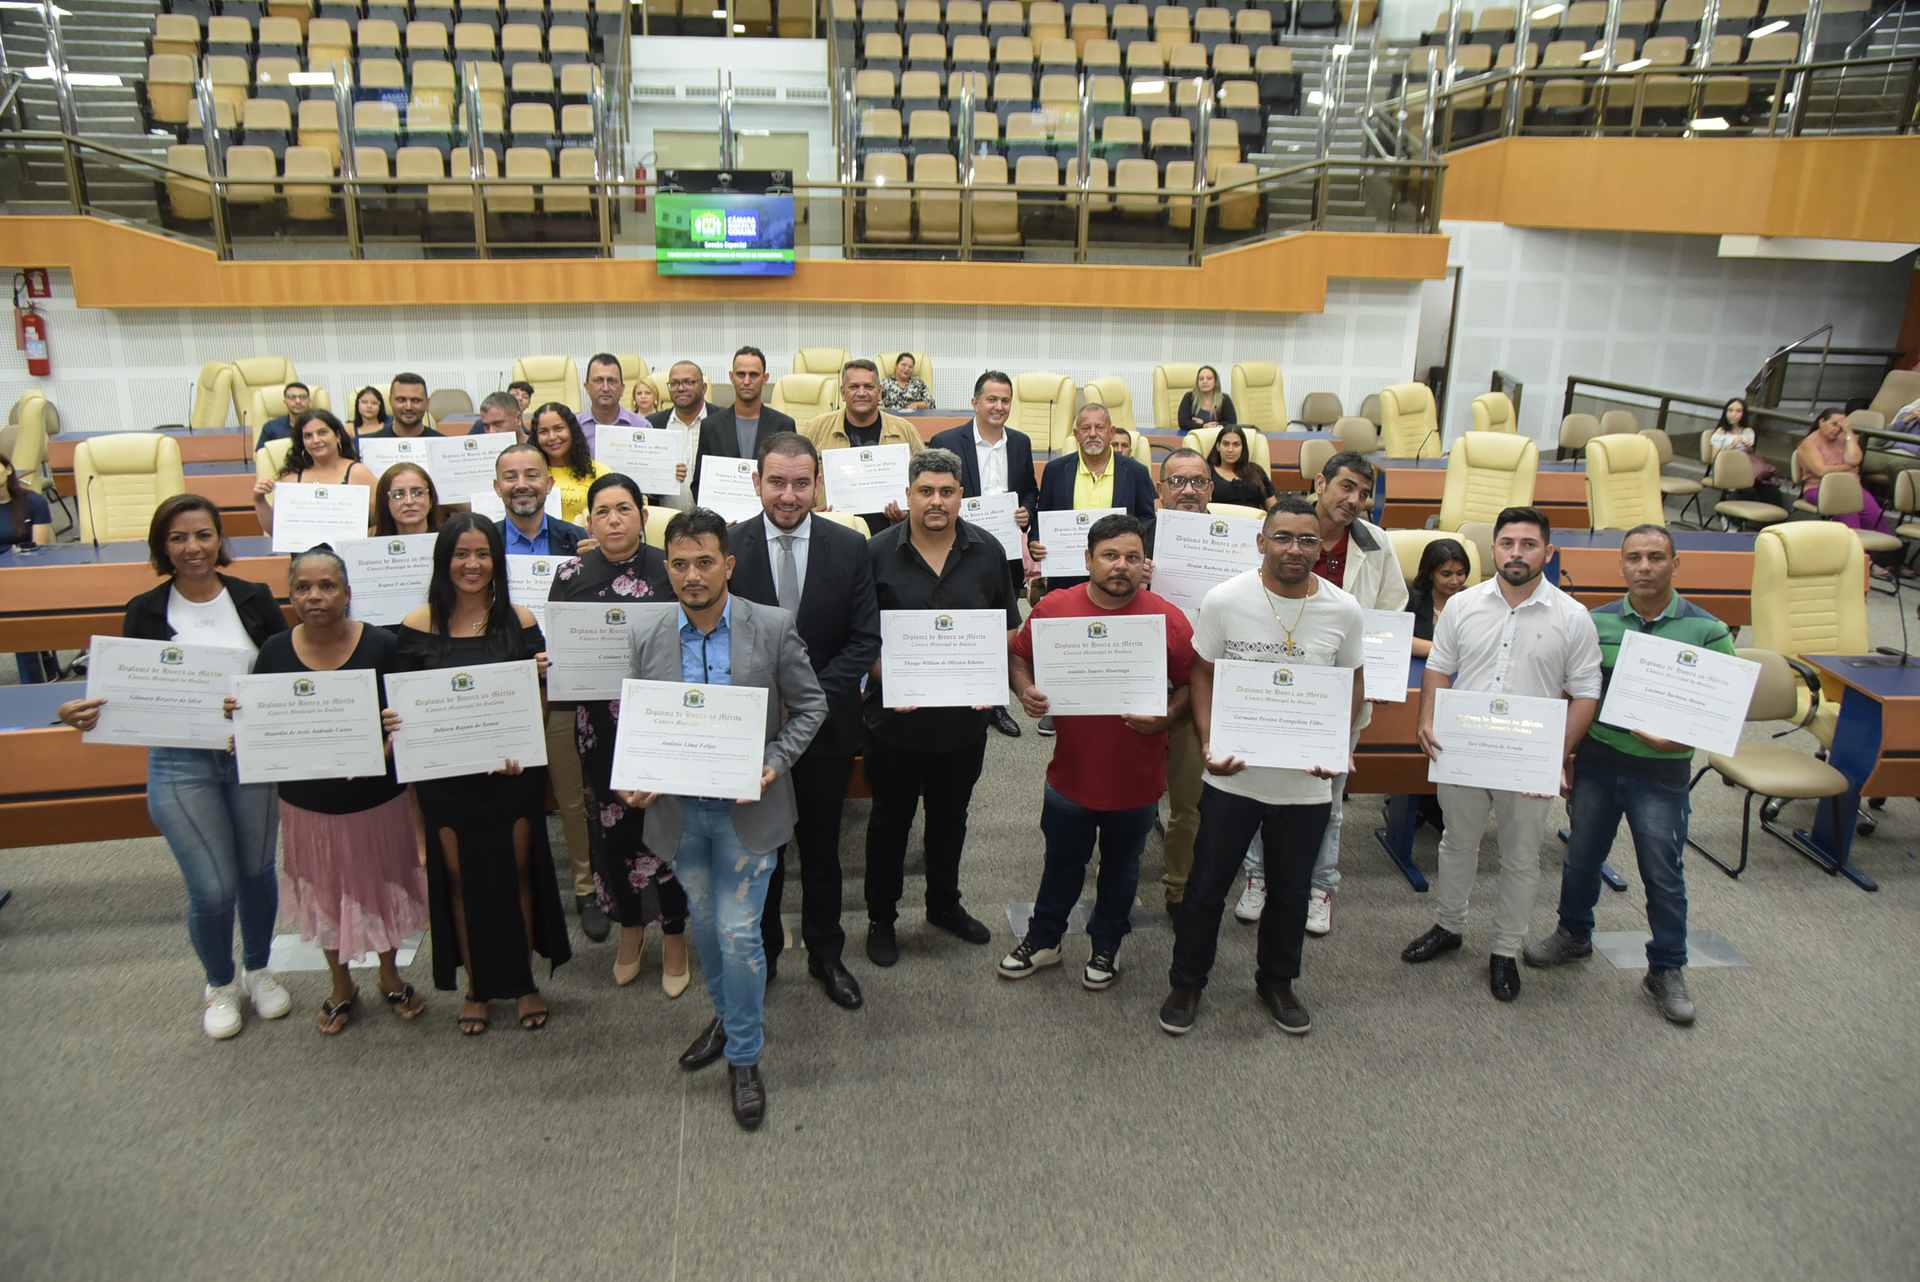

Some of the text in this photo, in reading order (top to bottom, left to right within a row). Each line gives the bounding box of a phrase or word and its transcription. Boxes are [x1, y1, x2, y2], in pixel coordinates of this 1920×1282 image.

[1176, 535, 1200, 543] Diploma
[1211, 538, 1229, 547] Honra
[194, 620, 216, 628] LOVE
[118, 664, 150, 672] Diploma
[162, 667, 186, 675] Honra
[198, 669, 222, 677] Mérito
[1639, 658, 1665, 670] Diploma
[1676, 666, 1696, 677] Honra
[415, 698, 444, 706] Diploma
[491, 689, 515, 698] Mérito
[1236, 686, 1263, 694] Diploma
[1306, 690, 1328, 699] Mérito
[258, 701, 287, 709] Diploma
[332, 696, 355, 705] Mérito
[645, 708, 674, 717] Diploma
[719, 713, 742, 721] Mérito
